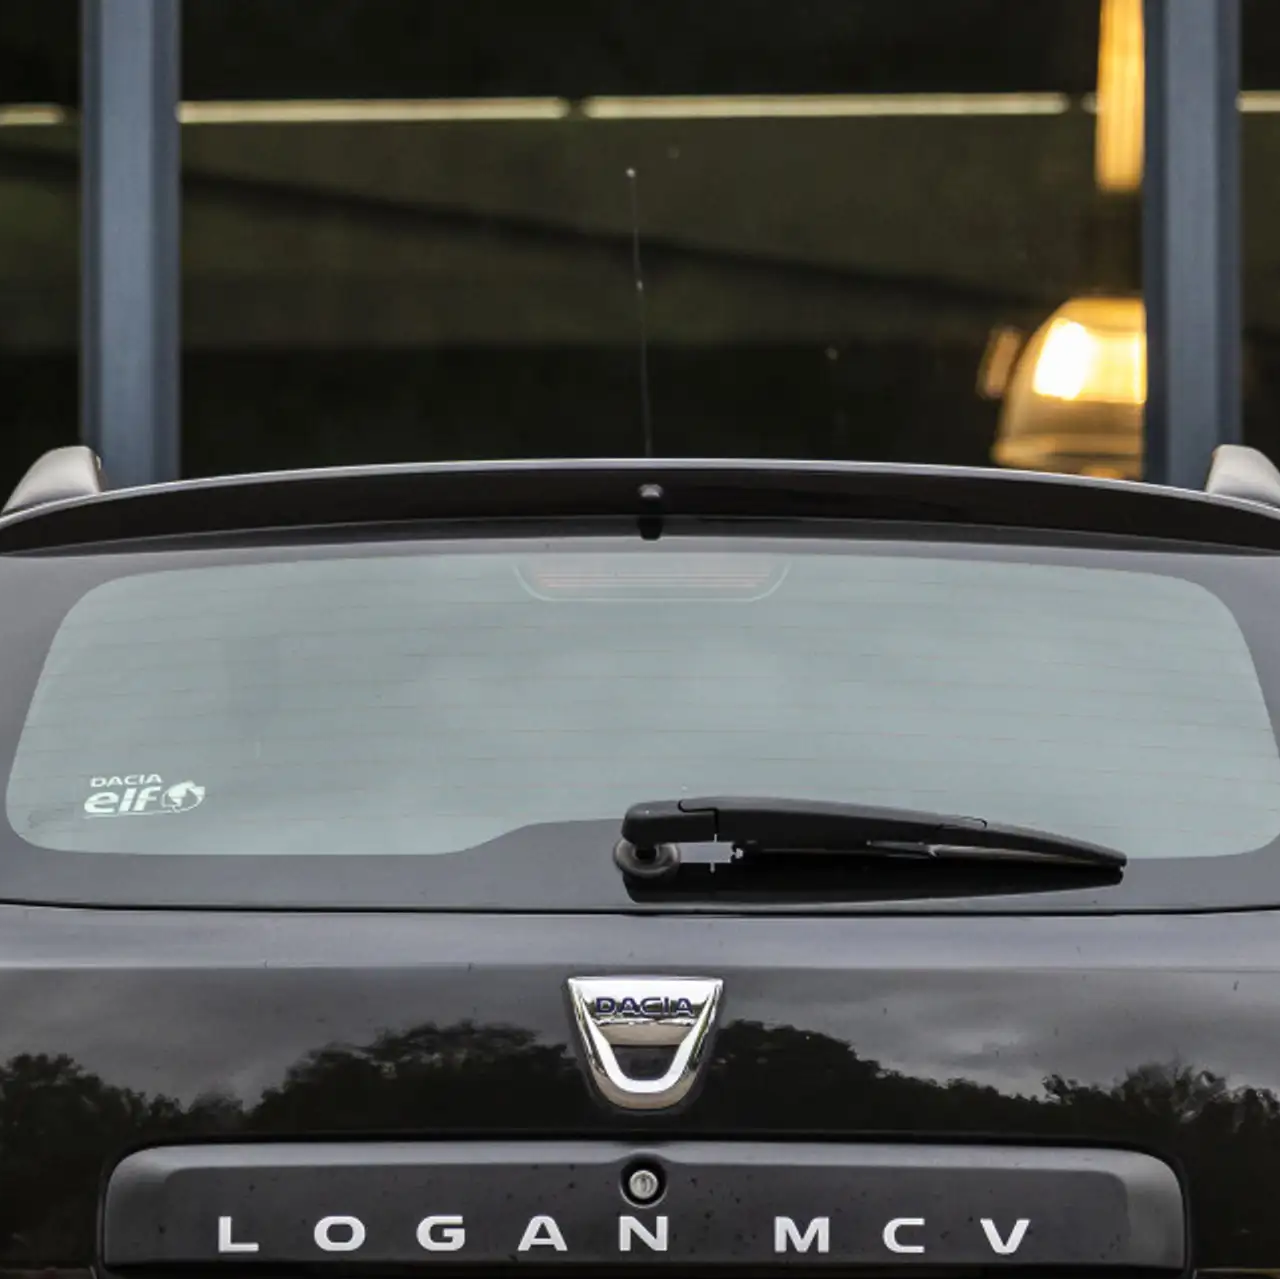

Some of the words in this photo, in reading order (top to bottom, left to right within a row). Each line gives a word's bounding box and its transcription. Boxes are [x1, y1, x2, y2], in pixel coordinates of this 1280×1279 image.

[90, 773, 163, 788] DACIA
[84, 786, 161, 813] elf
[595, 997, 694, 1016] DACIA
[217, 1214, 670, 1253] LOGAN
[773, 1215, 1031, 1254] MCV
